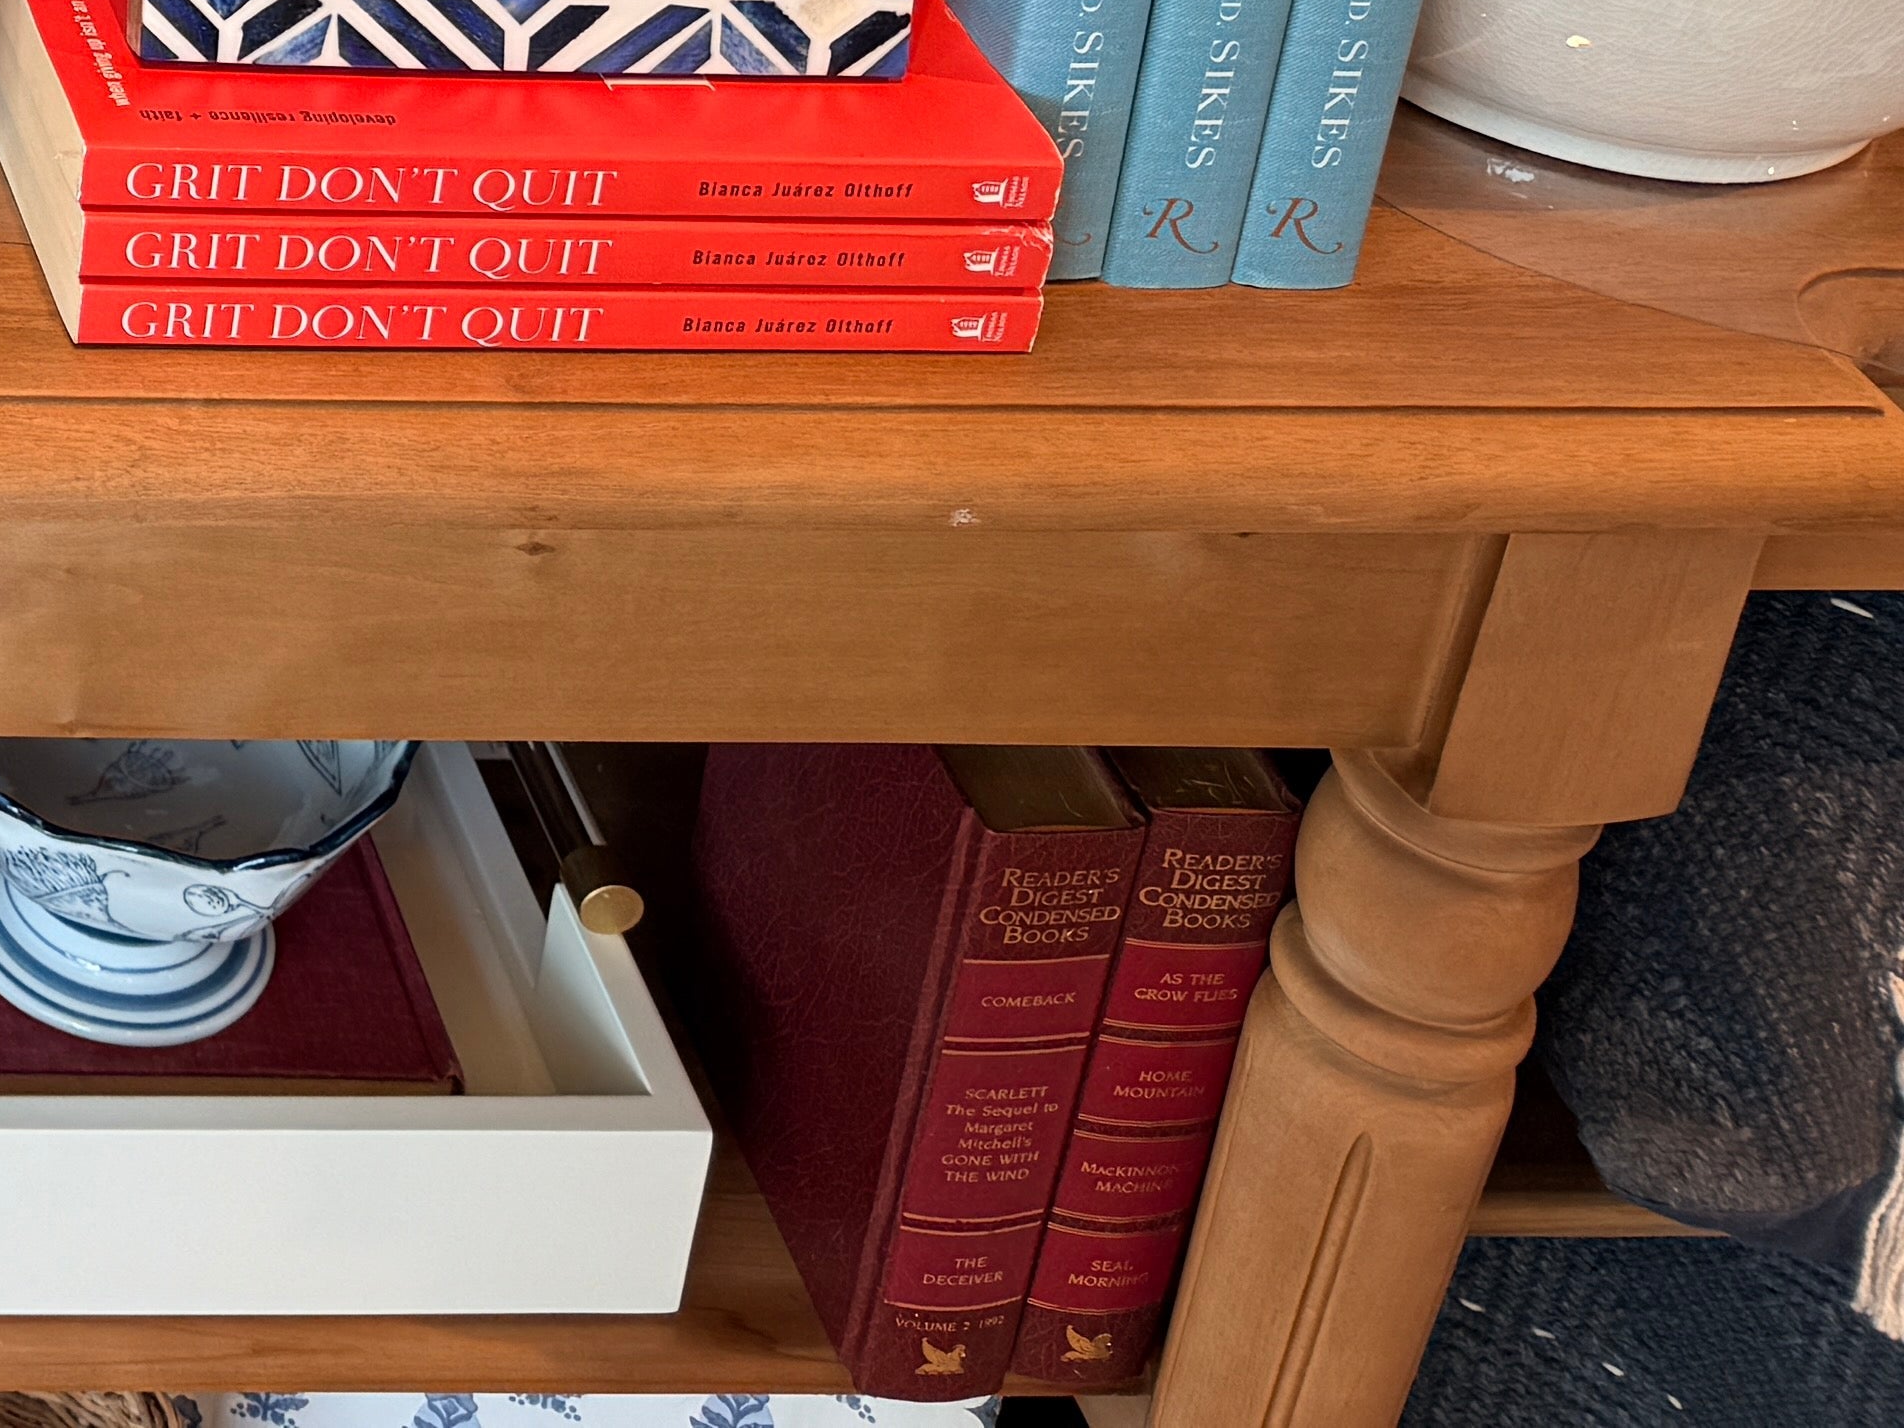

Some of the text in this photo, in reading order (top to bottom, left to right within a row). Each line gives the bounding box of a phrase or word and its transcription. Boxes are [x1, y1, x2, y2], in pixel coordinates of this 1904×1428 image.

[1216, 2, 1241, 25] D.
[1345, 1, 1371, 24] D.
[1058, 31, 1105, 160] SIKES
[1185, 39, 1240, 169] SIKES
[1311, 39, 1369, 169] SIKES
[139, 110, 182, 122] faith
[208, 110, 295, 124] resilience
[299, 110, 396, 125] developing
[125, 162, 617, 211] GRIT DON'T QUIT
[698, 181, 914, 198] Bianca Juárez Olthoff
[1143, 197, 1220, 254] R
[1265, 197, 1343, 254] R
[125, 231, 613, 279] GRIT DON'T QUIT
[693, 250, 905, 267] Bianca Juárez Olthoff
[121, 301, 604, 347] GRIT DON'T QUIT
[683, 317, 894, 334] Bianca Juárez Olthoff
[1162, 848, 1283, 871] READER'S
[1001, 868, 1120, 888] READER'S
[1170, 870, 1267, 890] DIGEST
[1010, 887, 1104, 907] DIGEST
[1139, 887, 1281, 909] CONDENSED
[979, 906, 1120, 926] CONDENSED
[1162, 908, 1251, 929] BOOKS
[1003, 926, 1090, 945] BOOKS
[1159, 973, 1225, 985] AS THE
[981, 992, 1076, 1008] COMEBACK
[1134, 988, 1239, 1002] CROW FLIES
[1139, 1070, 1191, 1082] HOME
[964, 1086, 1050, 1101] SCARLETT
[1113, 1085, 1205, 1099] MOUNTAIN
[945, 1102, 1059, 1118] The Sequel to
[964, 1121, 1033, 1136] Margaret
[942, 1151, 1040, 1166] GONE WITH
[944, 1168, 1030, 1183] THE WIND
[954, 1256, 989, 1269] THE
[923, 1271, 1003, 1286] DECEIVER
